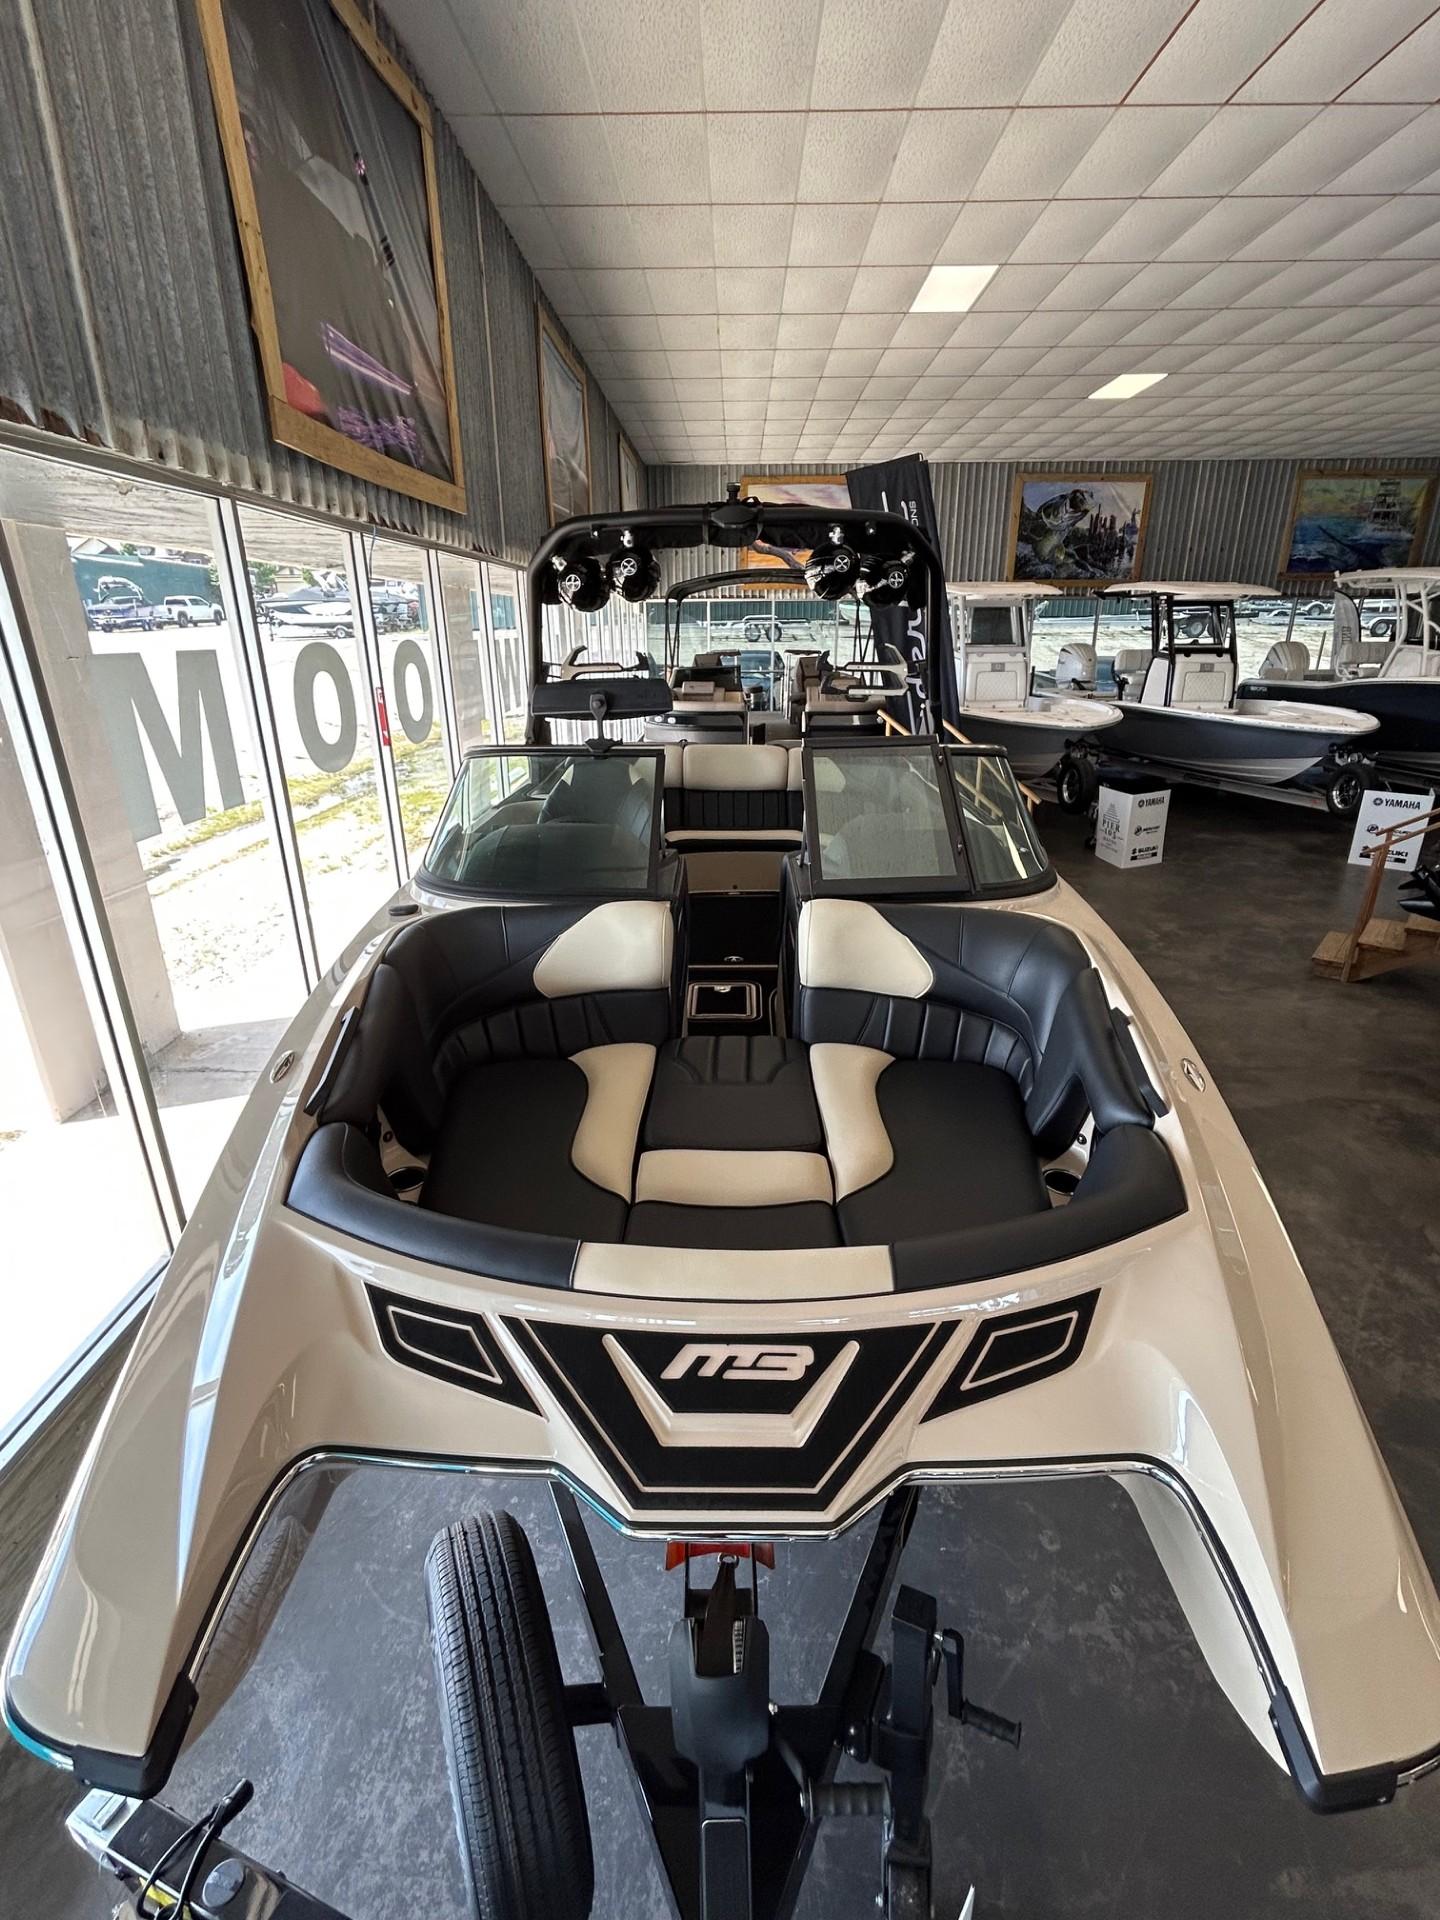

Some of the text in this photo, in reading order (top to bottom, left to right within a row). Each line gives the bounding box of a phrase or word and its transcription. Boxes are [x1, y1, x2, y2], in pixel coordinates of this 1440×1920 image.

[1145, 796, 1165, 807] YAMAHA
[1384, 798, 1421, 810] YAMAHA
[1102, 818, 1121, 833] PIER
